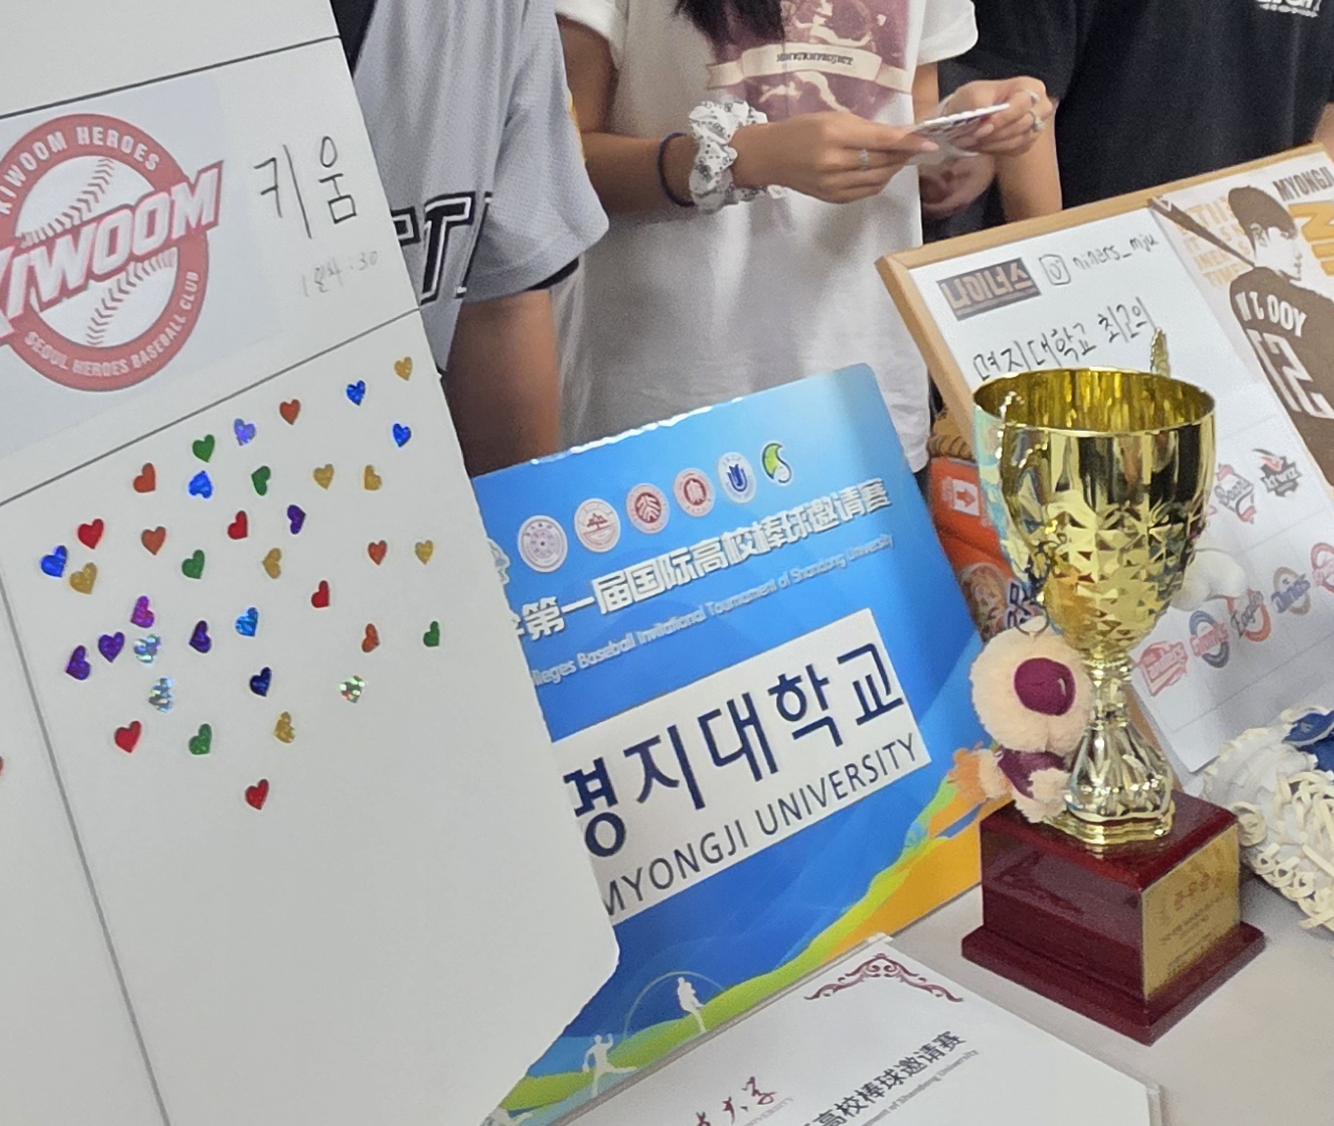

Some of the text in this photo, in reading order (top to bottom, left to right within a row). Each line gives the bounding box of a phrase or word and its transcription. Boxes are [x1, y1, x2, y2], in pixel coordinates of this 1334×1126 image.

[76, 126, 160, 171] HEROES
[254, 136, 357, 240] 키움
[576, 632, 636, 669] Baseball
[637, 605, 708, 645] Invitational
[705, 579, 777, 616] Tournament
[778, 571, 791, 589] of
[790, 553, 847, 584] Shandong
[847, 533, 893, 561] University
[563, 643, 904, 858] 명지대학교
[755, 732, 918, 836] UNIVERSITY
